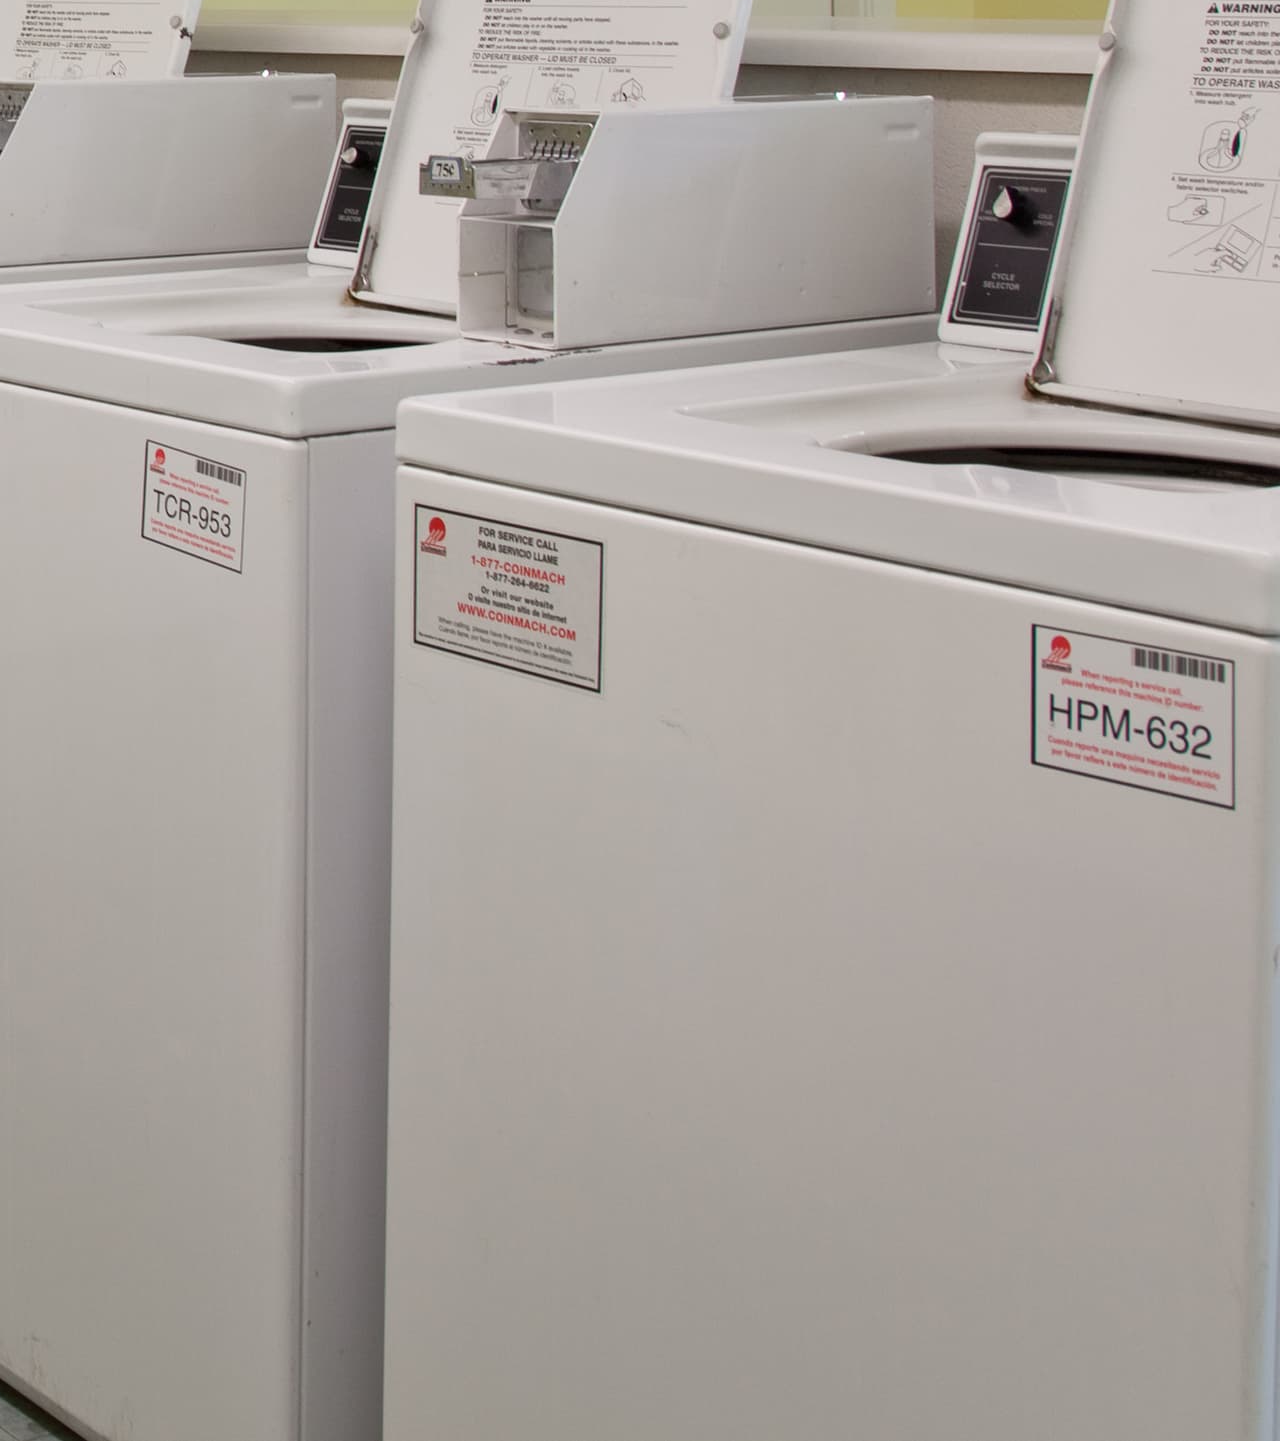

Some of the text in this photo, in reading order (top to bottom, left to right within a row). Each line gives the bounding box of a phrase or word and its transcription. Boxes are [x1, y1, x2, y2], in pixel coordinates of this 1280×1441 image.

[1221, 3, 1280, 14] WARNING
[1202, 56, 1214, 64] DO
[1193, 76, 1207, 86] TO
[1208, 77, 1256, 88] OPERATE
[982, 279, 1020, 291] SELECTOR
[991, 271, 1016, 282] CYCLE
[153, 488, 231, 538] TCR-953
[479, 526, 559, 552] FOR SERVICE CALL
[478, 539, 559, 566] PARA SERVICIO LLAME
[471, 555, 566, 586] 1-877-COINMACH
[492, 588, 508, 600] visit
[524, 596, 554, 610] website
[457, 601, 577, 642] WWW.COINMACH.COM
[1049, 693, 1212, 760] HPM-632
